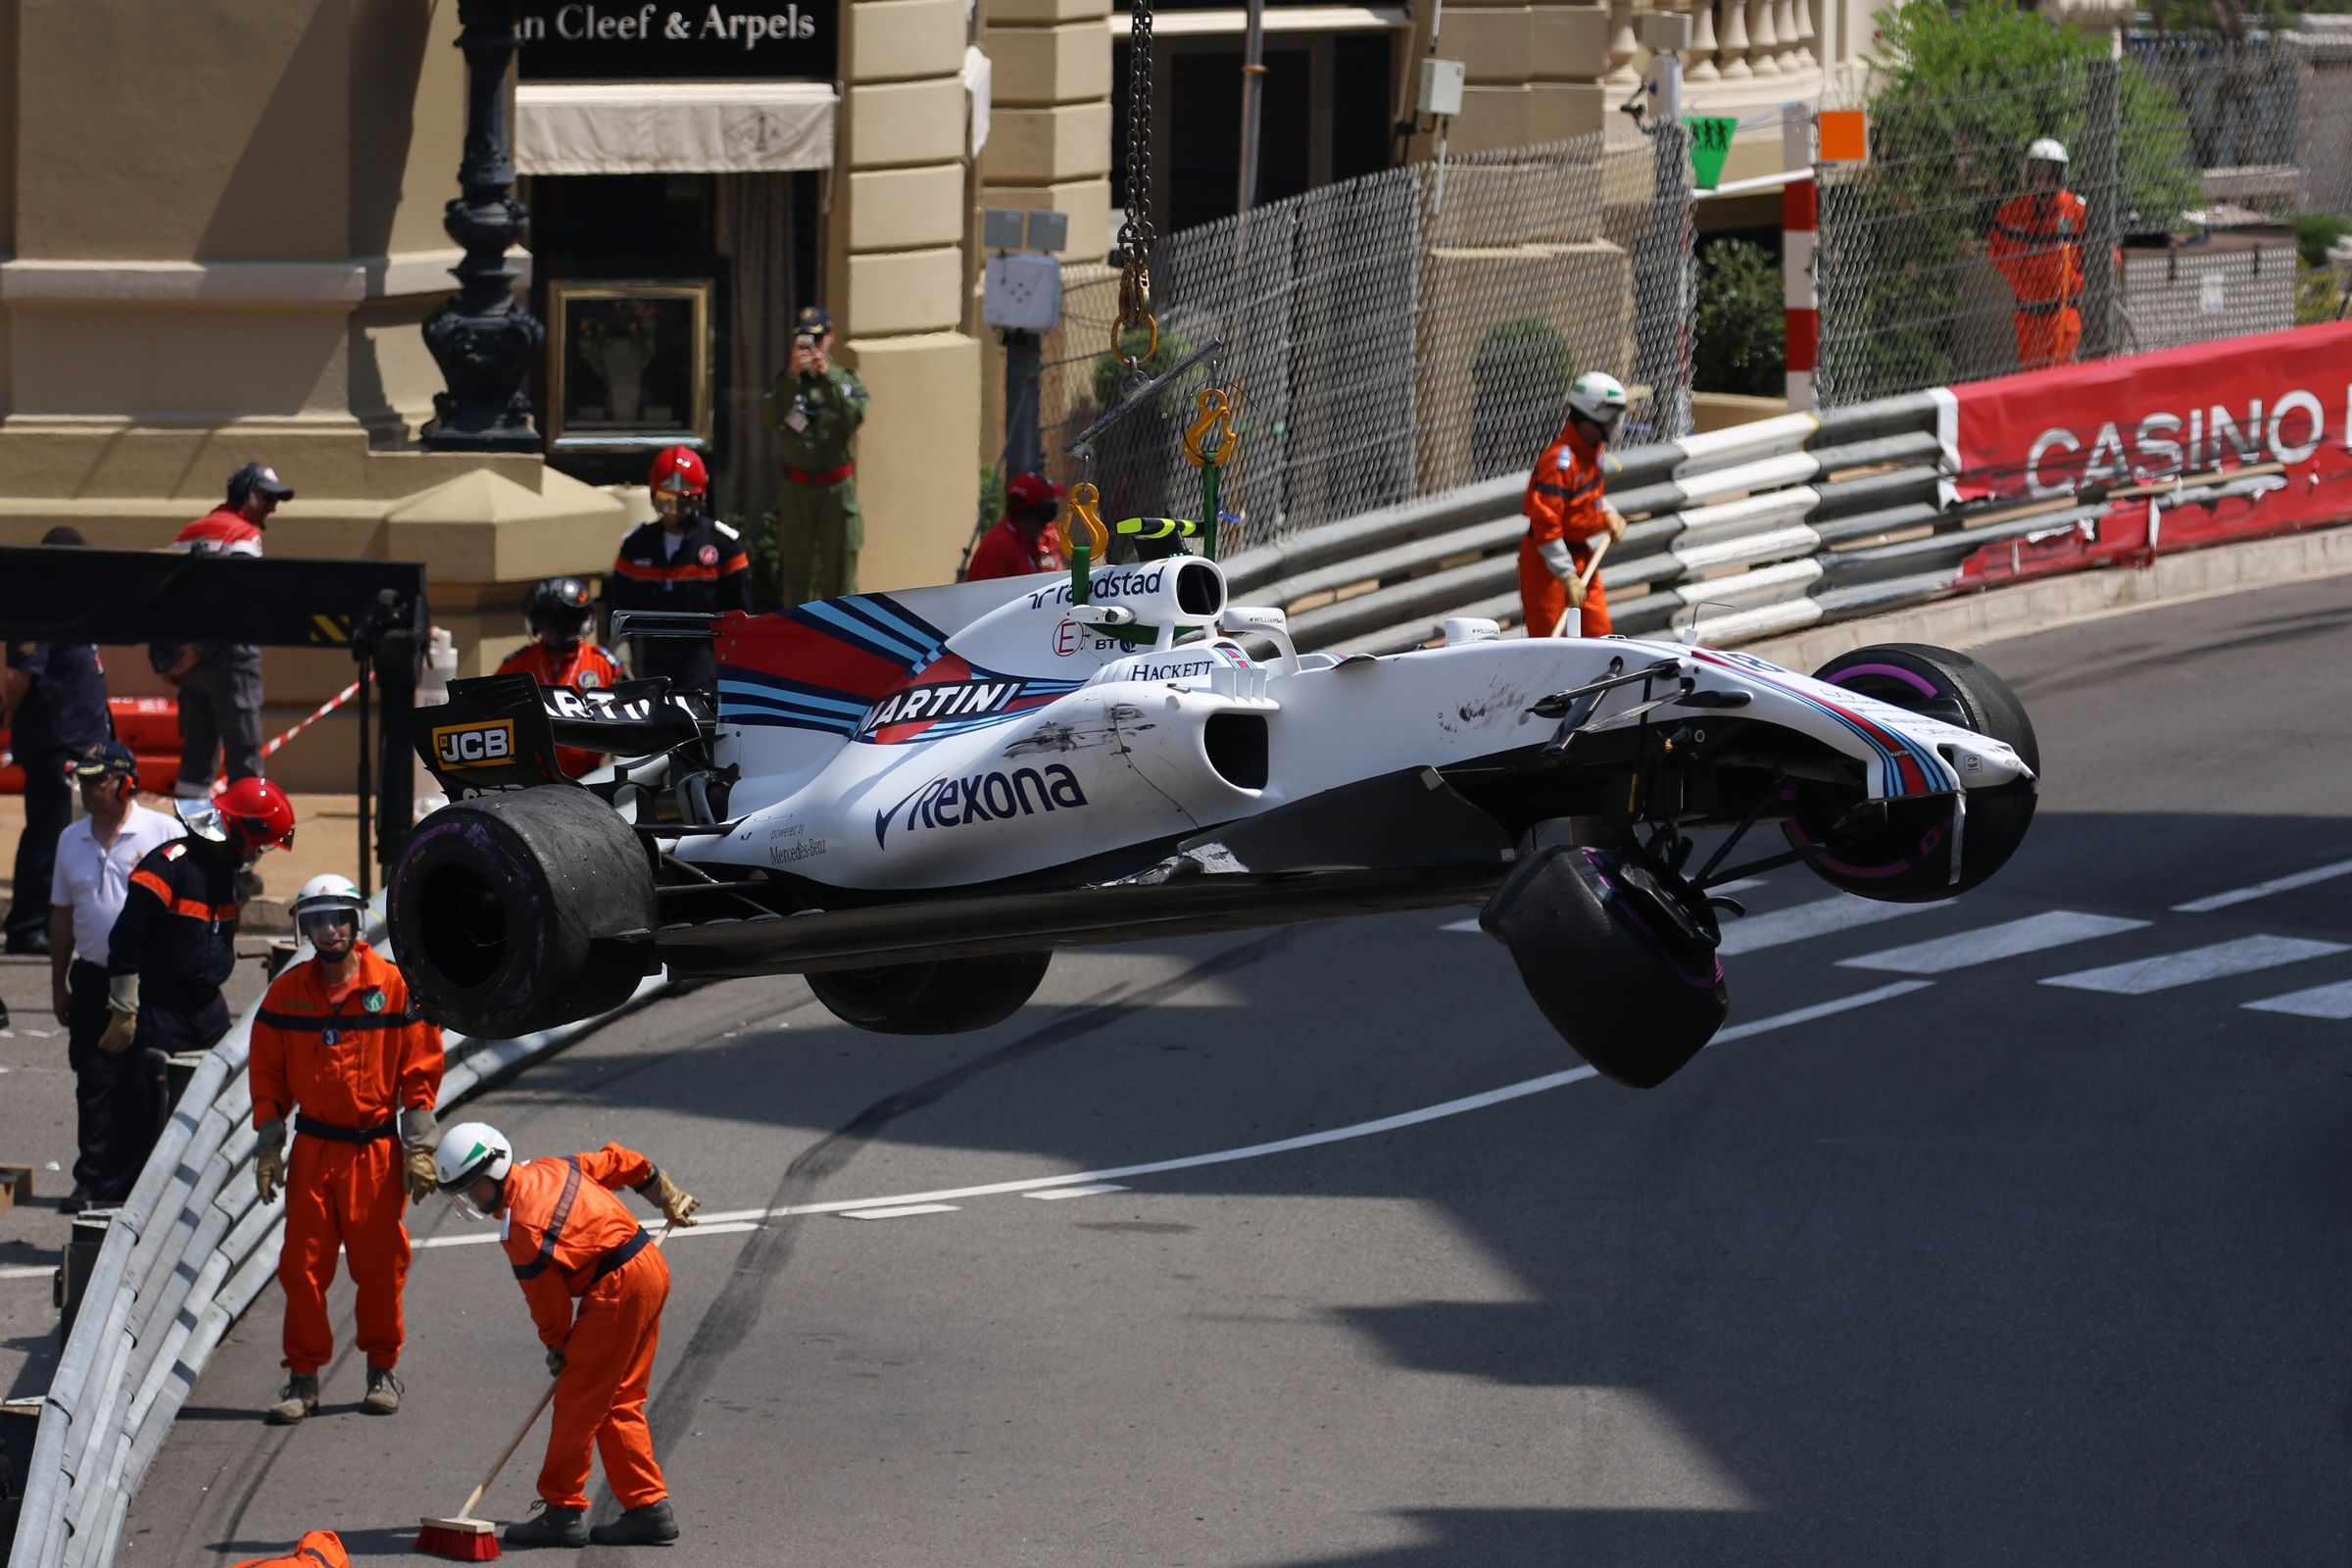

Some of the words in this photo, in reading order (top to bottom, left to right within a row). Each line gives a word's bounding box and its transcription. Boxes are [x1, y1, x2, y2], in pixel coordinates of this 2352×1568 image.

[556, 4, 657, 40] Cleef
[663, 12, 690, 39] &
[698, 3, 815, 50] Arpels
[2026, 389, 2324, 499] CASINO
[1058, 621, 1077, 654] E
[1096, 639, 1117, 650] BT
[1131, 661, 1214, 681] HACKETT
[858, 683, 1021, 732] MARTINI
[441, 729, 508, 761] JCB
[905, 763, 1089, 832] Rexona
[770, 825, 796, 842] powered
[769, 839, 827, 864] Mercedes-Benz
